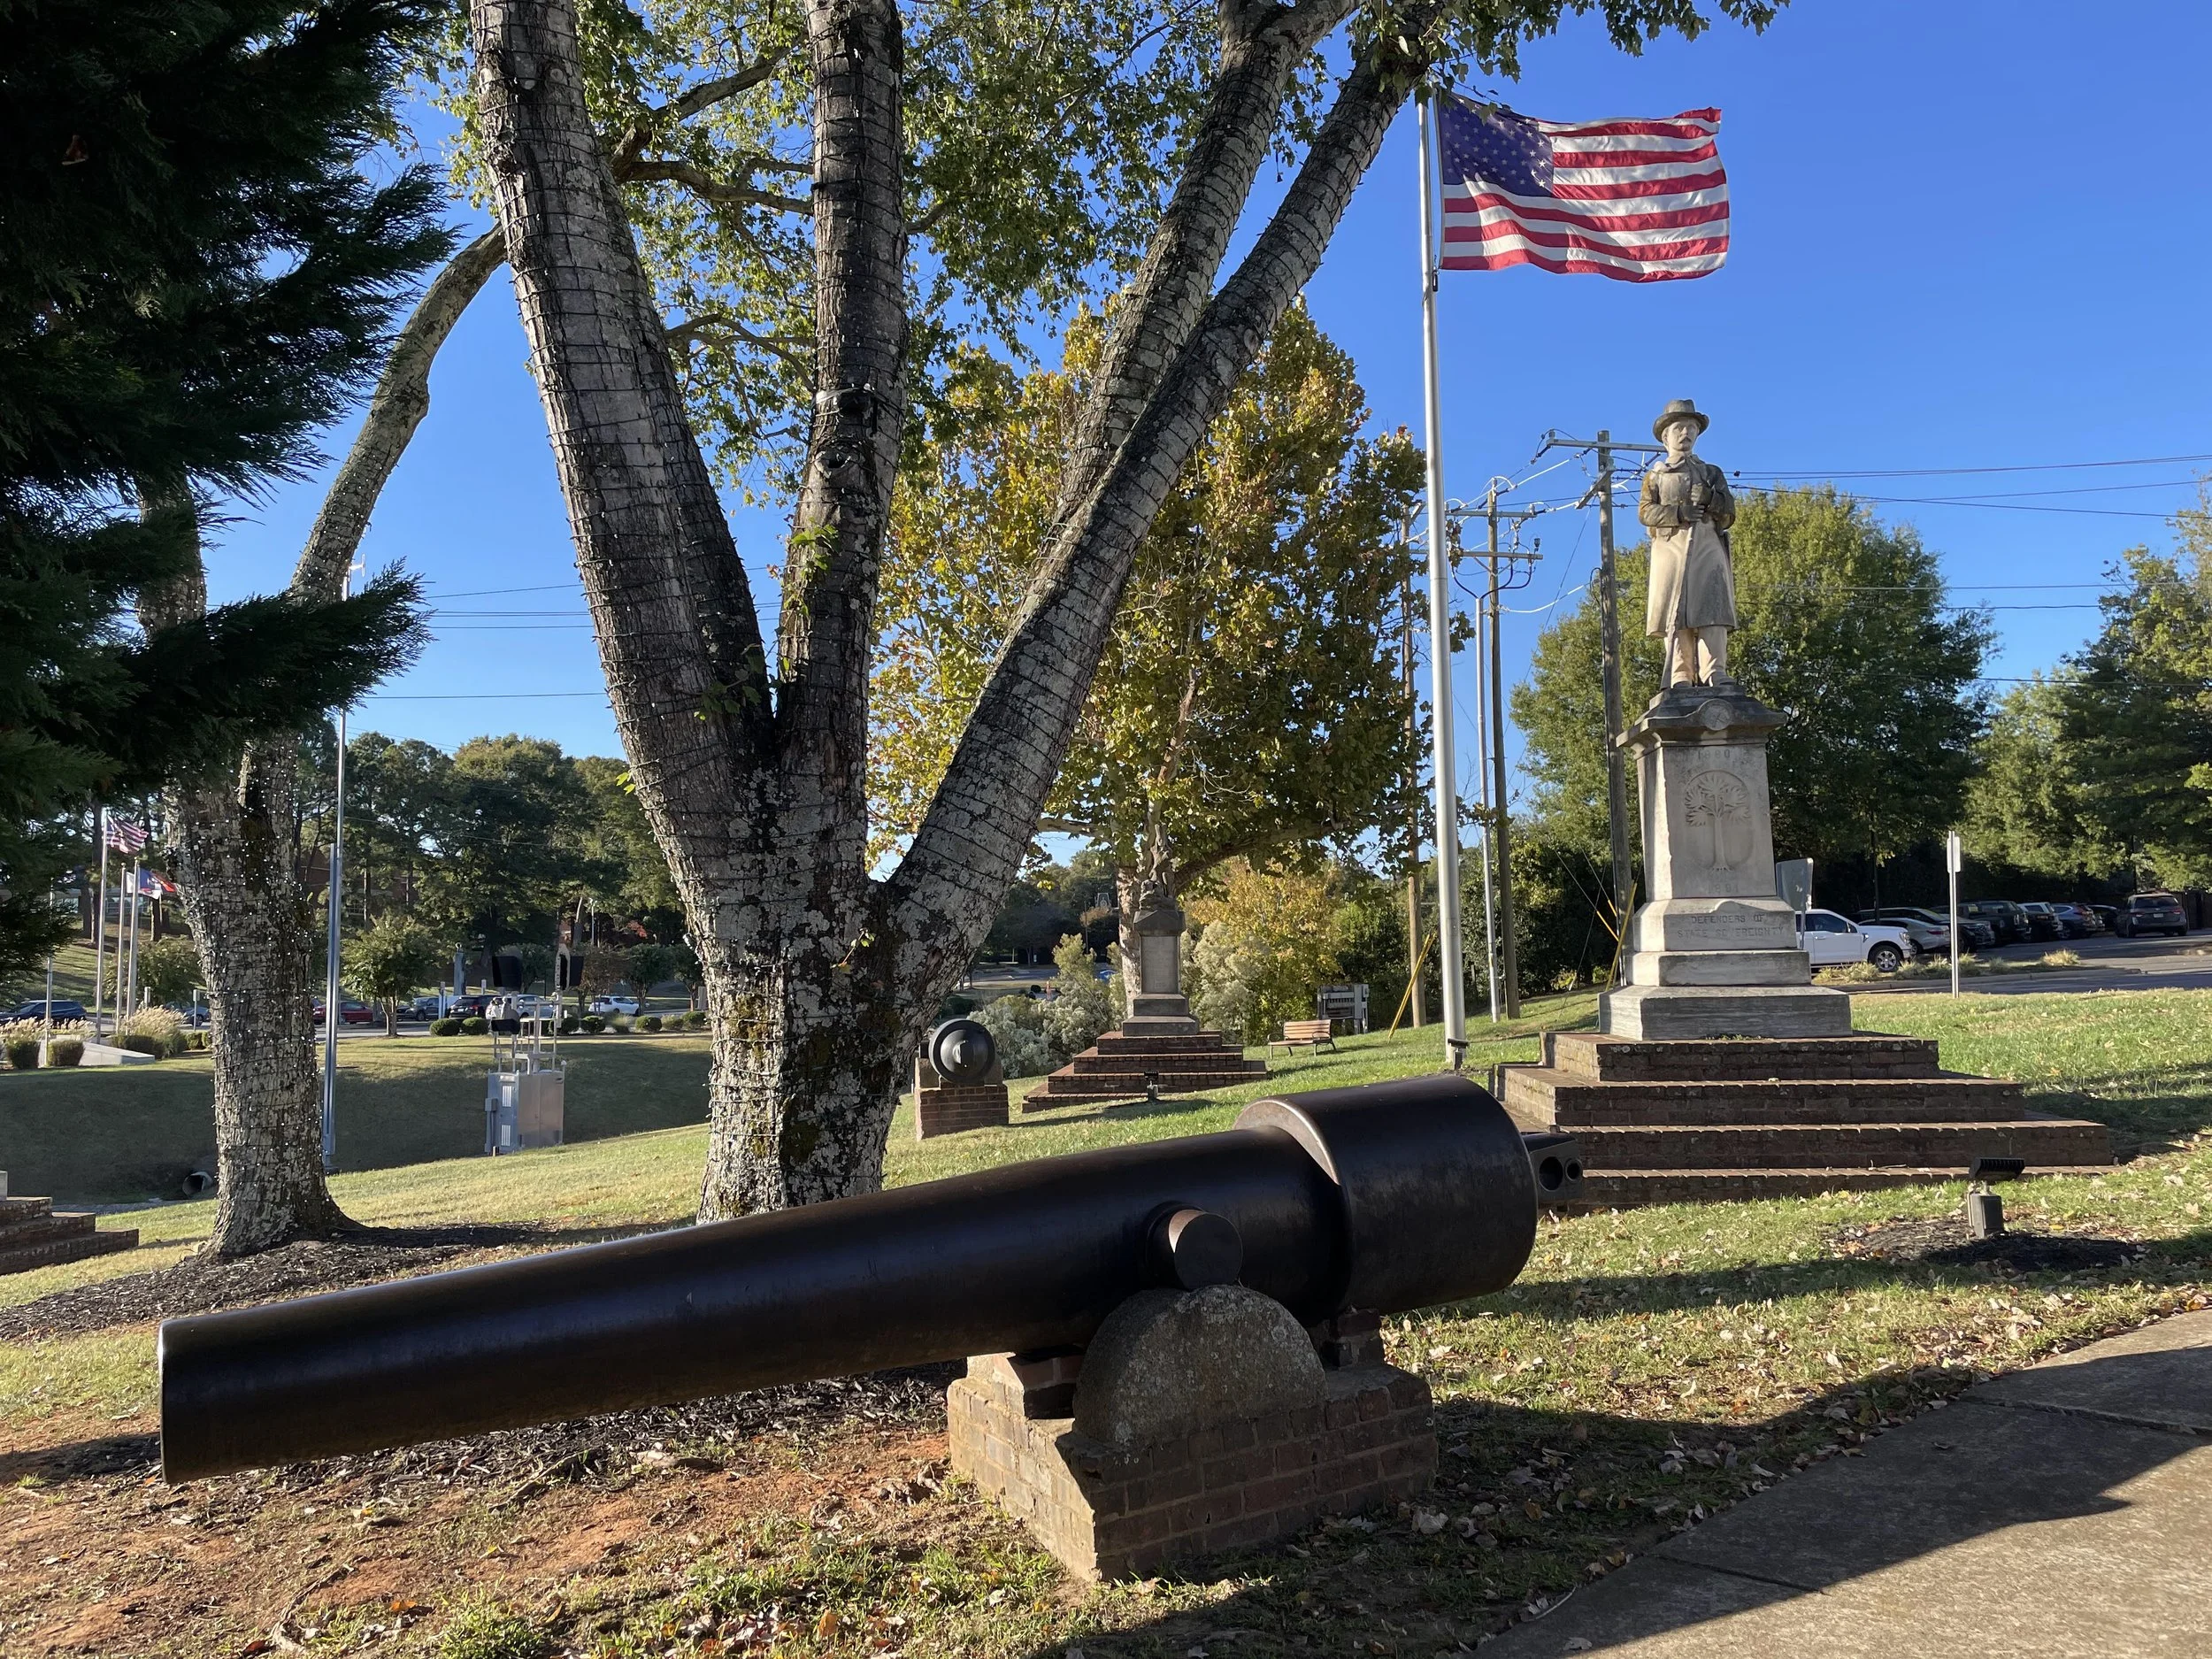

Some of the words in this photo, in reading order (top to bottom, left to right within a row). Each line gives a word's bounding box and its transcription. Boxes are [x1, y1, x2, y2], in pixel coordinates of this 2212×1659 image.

[1691, 915, 1746, 924] DEFENDERS
[1753, 914, 1765, 923] OF
[1678, 929, 1709, 938] STATE
[1716, 926, 1784, 938] SOEREIGNTY
